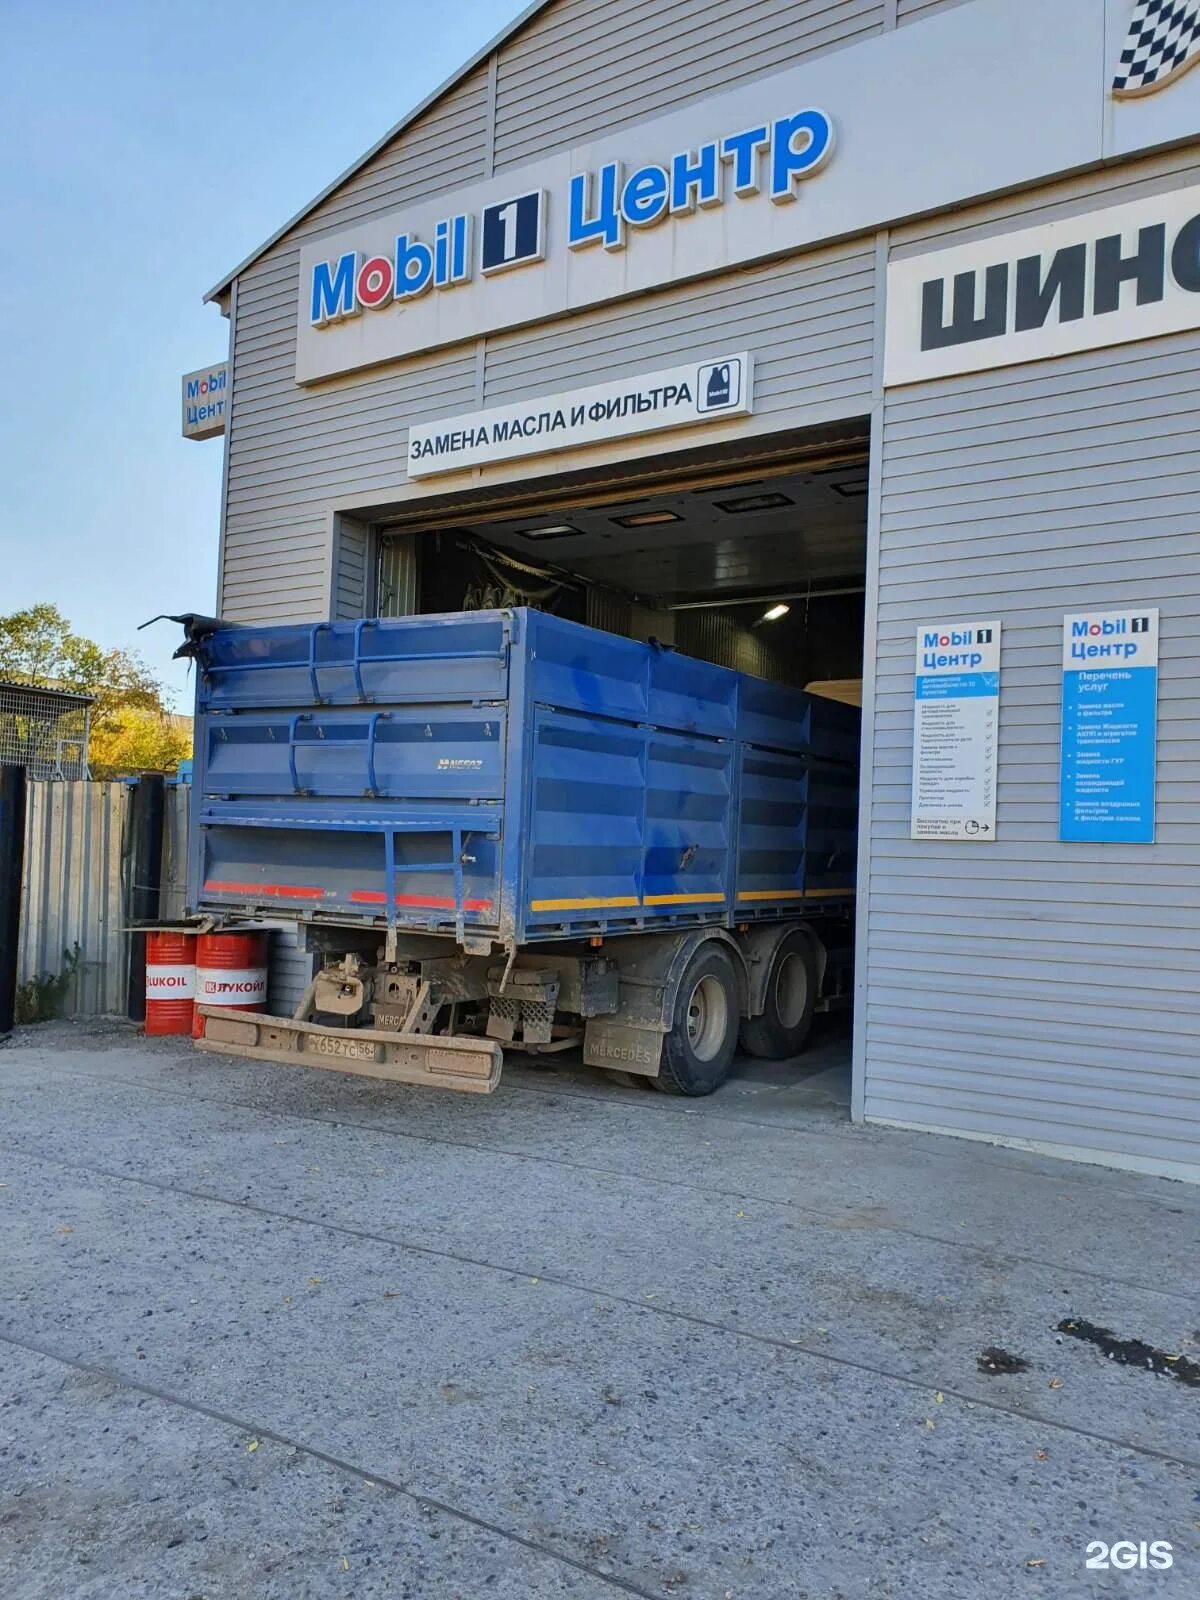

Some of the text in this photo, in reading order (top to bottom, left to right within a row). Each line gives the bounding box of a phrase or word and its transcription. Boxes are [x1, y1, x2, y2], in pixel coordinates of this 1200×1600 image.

[568, 107, 834, 249] Центр
[310, 213, 468, 324] Mobil
[187, 369, 226, 398] Mobil
[186, 400, 226, 424] Цент
[410, 383, 692, 459] ЗАМЕНА МАСЛА И ФИЛЬТРА
[1072, 618, 1126, 637] Mobil
[924, 630, 972, 648] Mobil
[1071, 642, 1137, 660] Центр
[923, 653, 982, 670] Центр
[1079, 672, 1132, 682] Перечень
[1078, 683, 1108, 693] услуг
[149, 976, 188, 987] LUKOIL
[217, 980, 265, 993] ЛУКОЙЛ
[590, 1043, 651, 1064] MERCEDES
